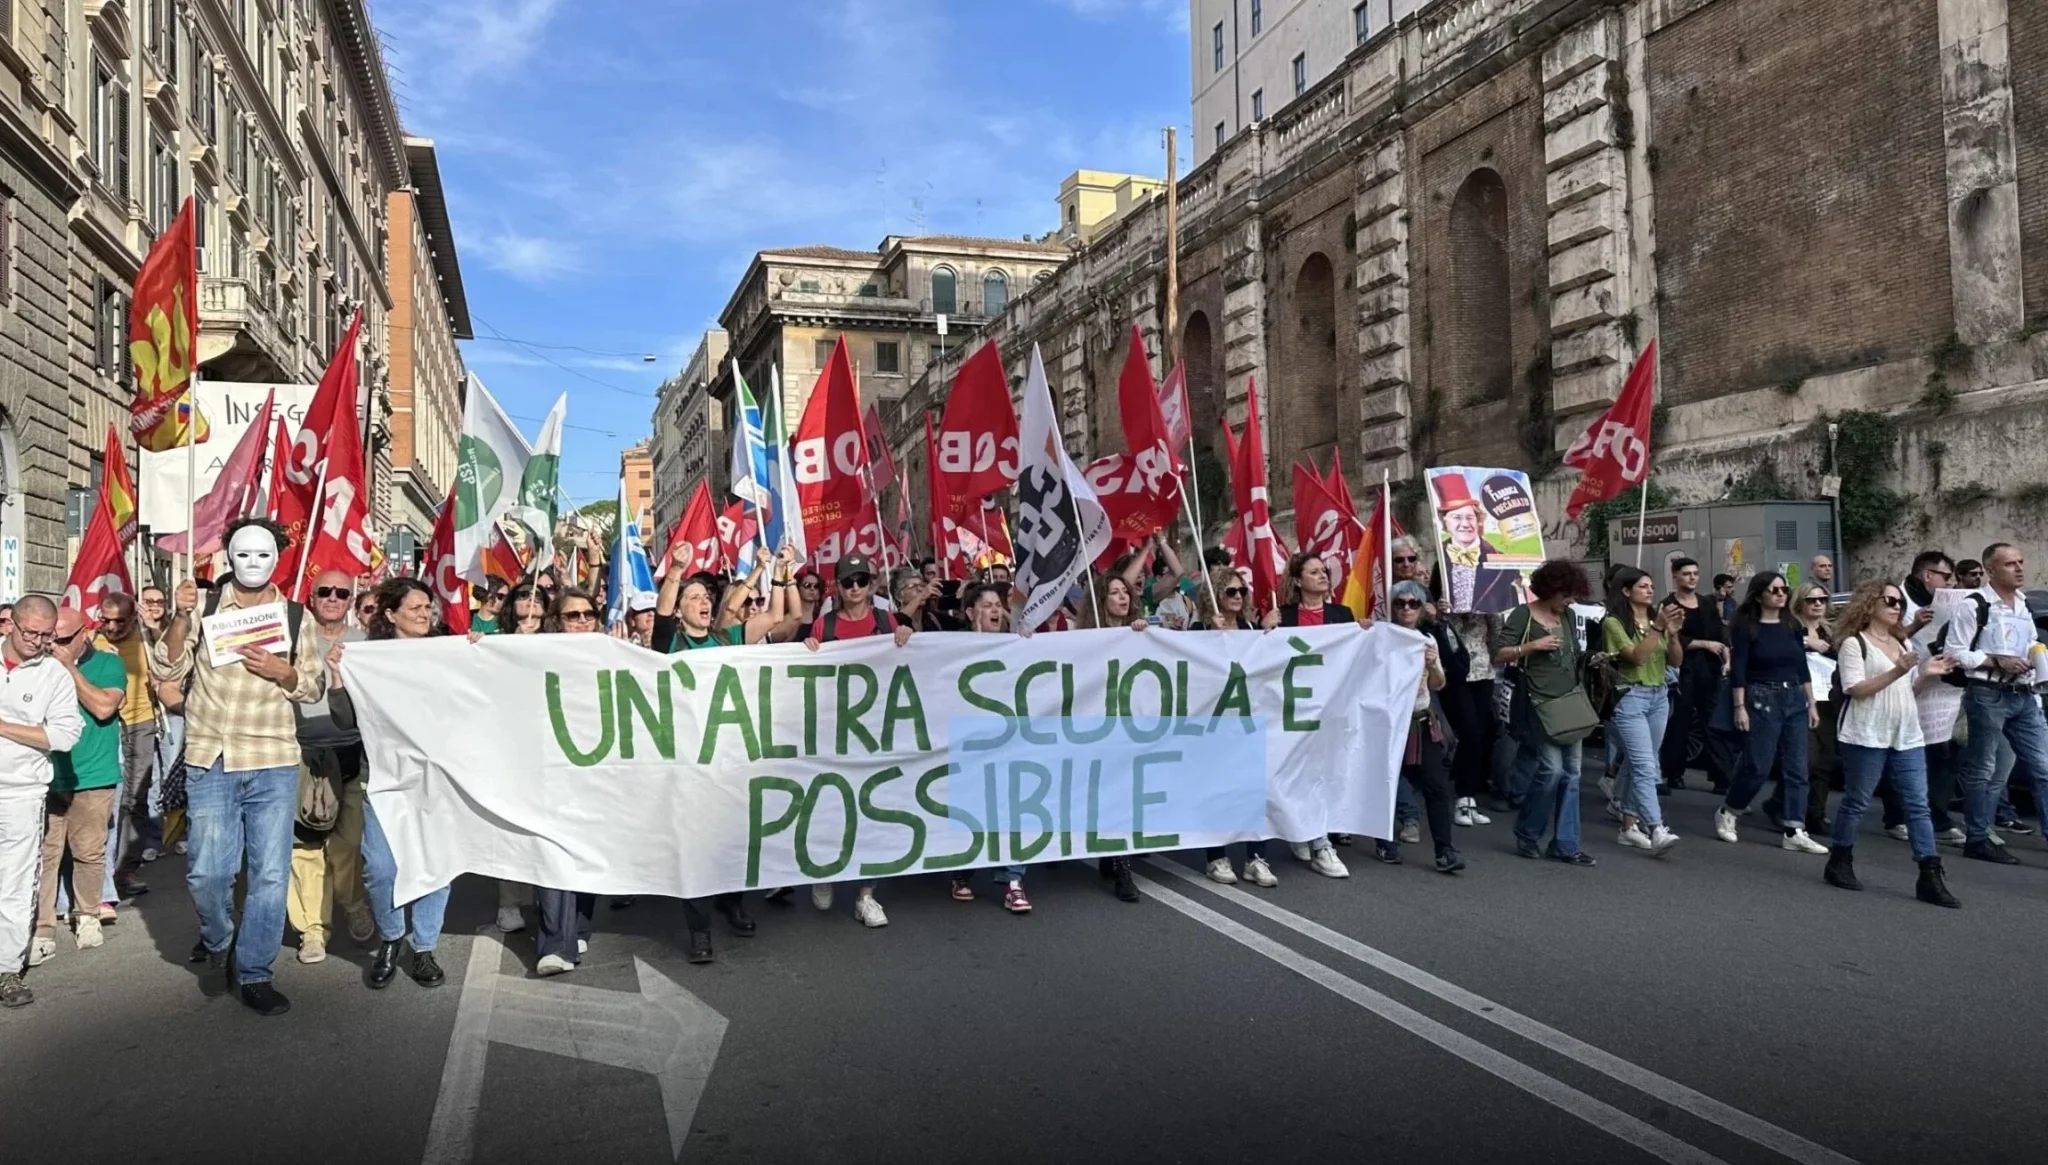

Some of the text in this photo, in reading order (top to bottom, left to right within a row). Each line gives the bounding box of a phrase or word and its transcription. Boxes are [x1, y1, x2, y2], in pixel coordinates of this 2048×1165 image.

[211, 611, 279, 631] ABILITAZIONE
[545, 635, 1324, 768] UN'ALTRA SCUOLA È
[745, 751, 1183, 888] POSSIBILE
